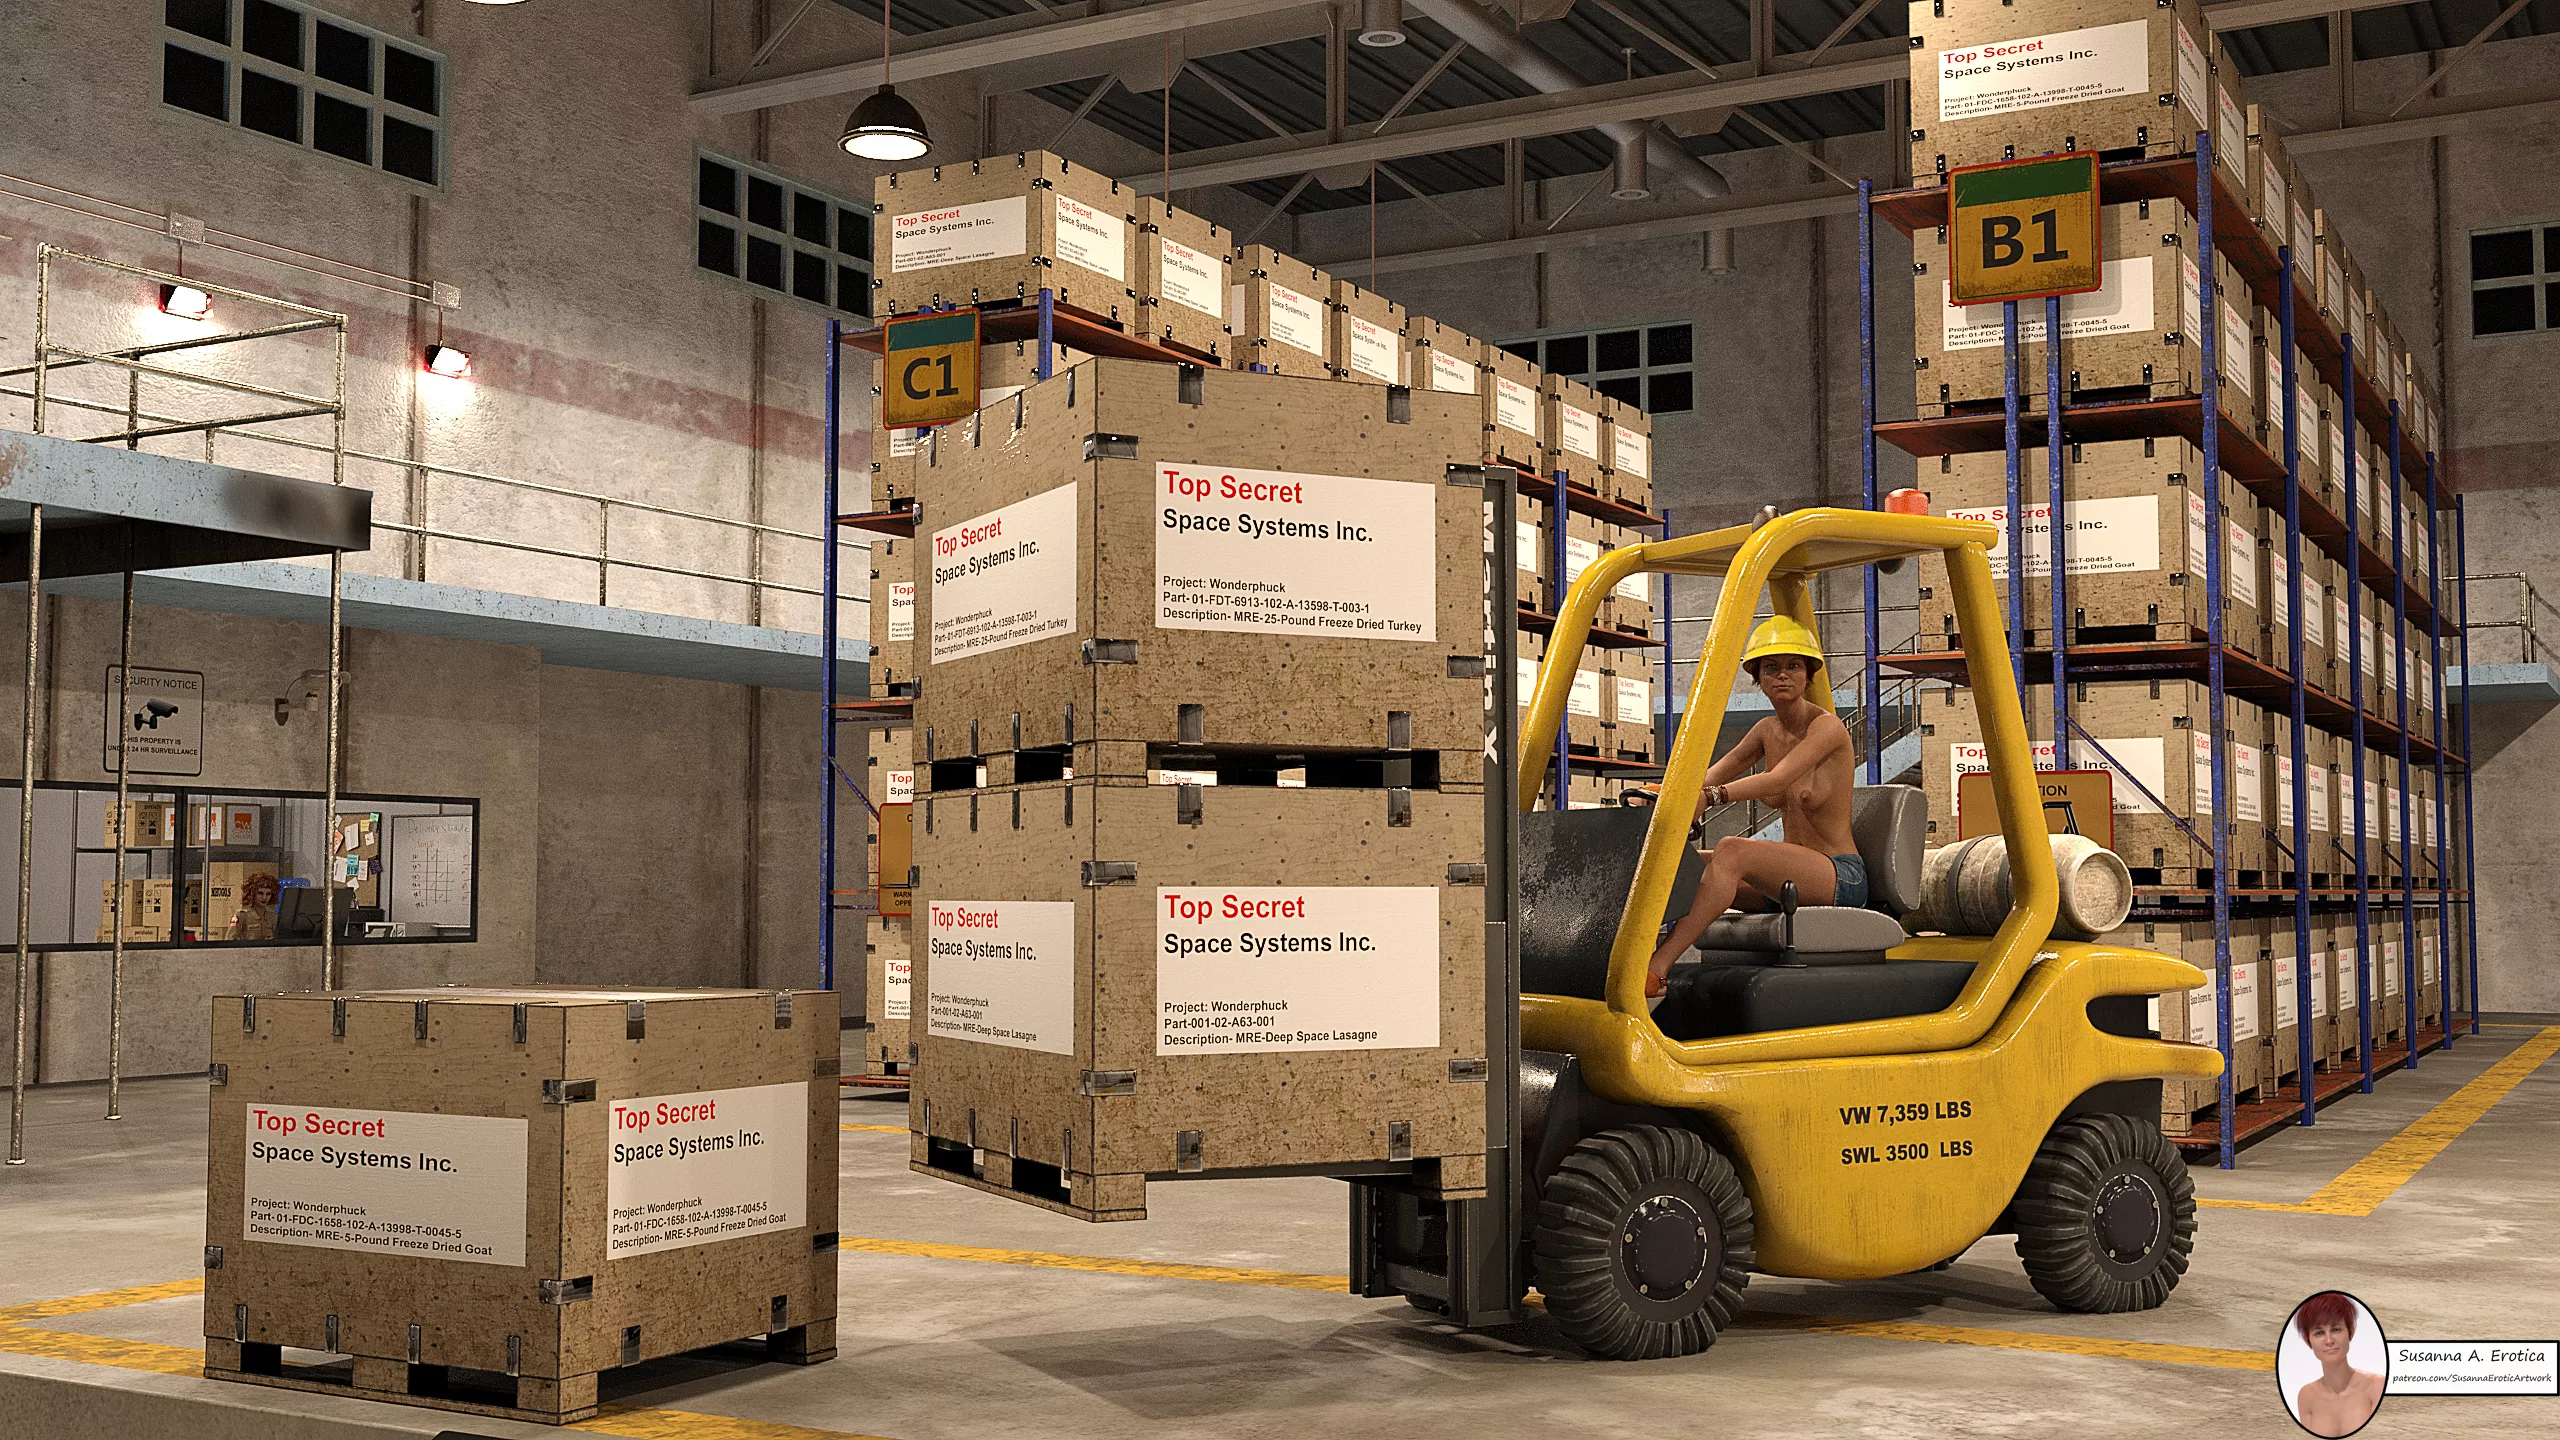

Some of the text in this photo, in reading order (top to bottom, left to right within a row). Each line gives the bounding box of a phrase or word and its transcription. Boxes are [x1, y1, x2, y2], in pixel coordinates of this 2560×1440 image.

[1942, 38, 2044, 63] Top Secret
[1943, 49, 2098, 79] Space Systems Inc.
[895, 209, 960, 226] Top Secret
[1058, 197, 1092, 220] Top Secret
[895, 218, 994, 239] Space Systems Inc.
[1058, 211, 1109, 239] Space Systems Inc.
[1163, 240, 1193, 261] Top Secret
[1981, 209, 2069, 269] B1
[1163, 254, 1208, 279] Space Systems Inc.
[1948, 325, 1978, 333] Project:
[1948, 338, 1996, 346] Description-
[902, 354, 959, 400] C1
[1162, 470, 1302, 504] Top Secret
[935, 516, 1002, 557] Top Secret
[1163, 508, 1372, 542] Space Systems Inc.
[935, 540, 1039, 586] Space Systems Inc.
[1163, 575, 1285, 593] Project: Wonderphuck
[934, 607, 992, 630] Project: Wonderphuck
[1163, 607, 1231, 622] Description-
[1318, 616, 1353, 628] Freeze
[1356, 618, 1384, 629] Dried
[1387, 619, 1421, 634] Turkey
[114, 675, 198, 690] SCURITY NOTICE
[107, 745, 131, 753] UNDR
[150, 747, 198, 755] SURVEILLANCE
[931, 906, 998, 931] Top Secret
[1164, 894, 1305, 924] Top Secret
[931, 937, 1036, 961] Space Systems Inc.
[1164, 931, 1375, 958] Space Systems Inc.
[931, 992, 989, 1008] Project: Wonderphuck
[1164, 999, 1288, 1015] Project: Wonderphuck
[931, 1018, 1037, 1043] Description- MRE-Deep Space Lasagne
[1164, 1029, 1377, 1046] Description- MRE-Deep Space Lasagne
[252, 1109, 385, 1138] Top Secret
[613, 1099, 715, 1133] Top Secret
[1839, 1101, 1972, 1126] VW 7,359 LBS
[252, 1141, 457, 1172] Space Systems Inc.
[613, 1129, 764, 1167] Space Systems Inc.
[1841, 1140, 1973, 1165] SWL 3500 LBS
[251, 1197, 366, 1215] Project: Wonderphuck
[613, 1196, 702, 1219] Project: Wonderphuck
[250, 1223, 312, 1237] Description-
[392, 1237, 428, 1249] Freeze
[432, 1240, 461, 1252] Dried
[464, 1243, 492, 1255] Goat
[612, 1233, 662, 1249] Description-
[720, 1221, 745, 1232] Freeze
[747, 1215, 767, 1228] Dried
[769, 1212, 786, 1224] Goat
